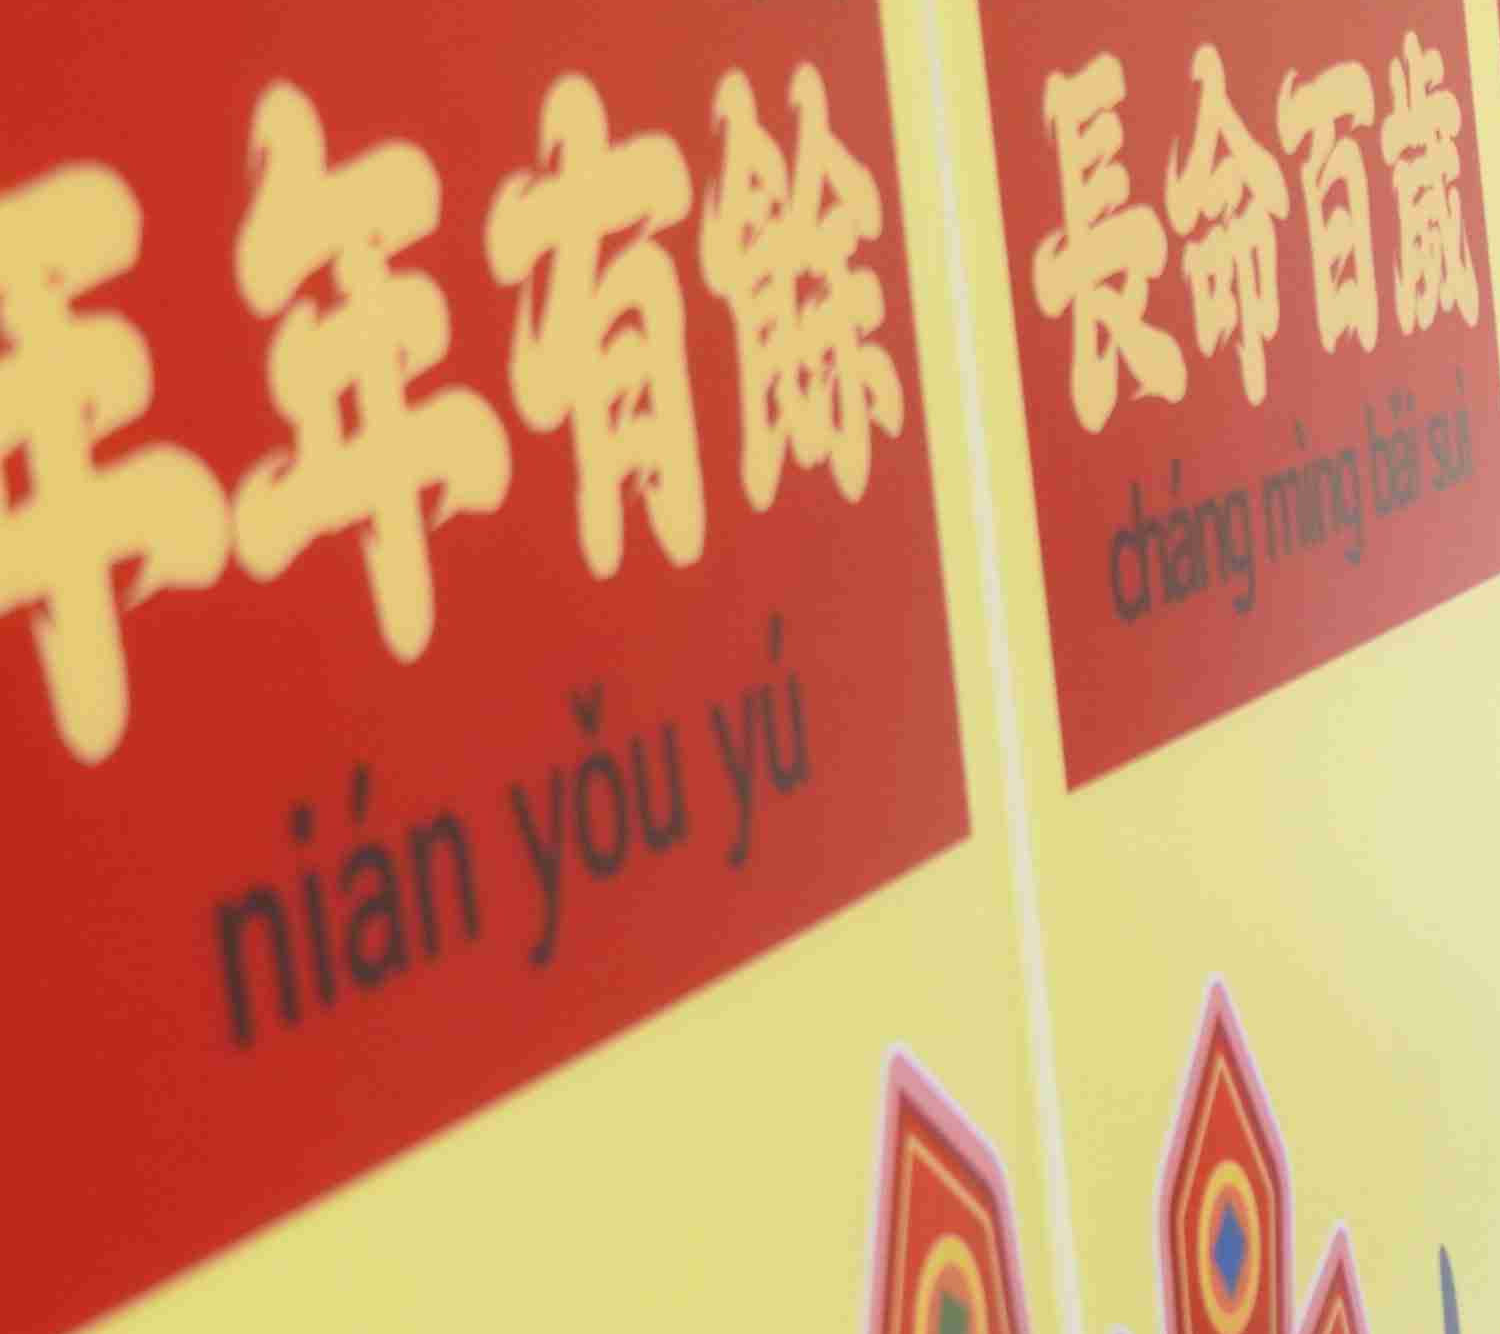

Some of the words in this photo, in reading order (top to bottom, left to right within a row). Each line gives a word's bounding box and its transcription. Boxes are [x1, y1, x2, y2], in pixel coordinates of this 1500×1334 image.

[0, 61, 905, 766] 年年有餘
[1032, 27, 1480, 436] 長命百歲
[211, 761, 481, 1048] nián
[510, 683, 690, 967] yǒu
[709, 613, 812, 868] yú
